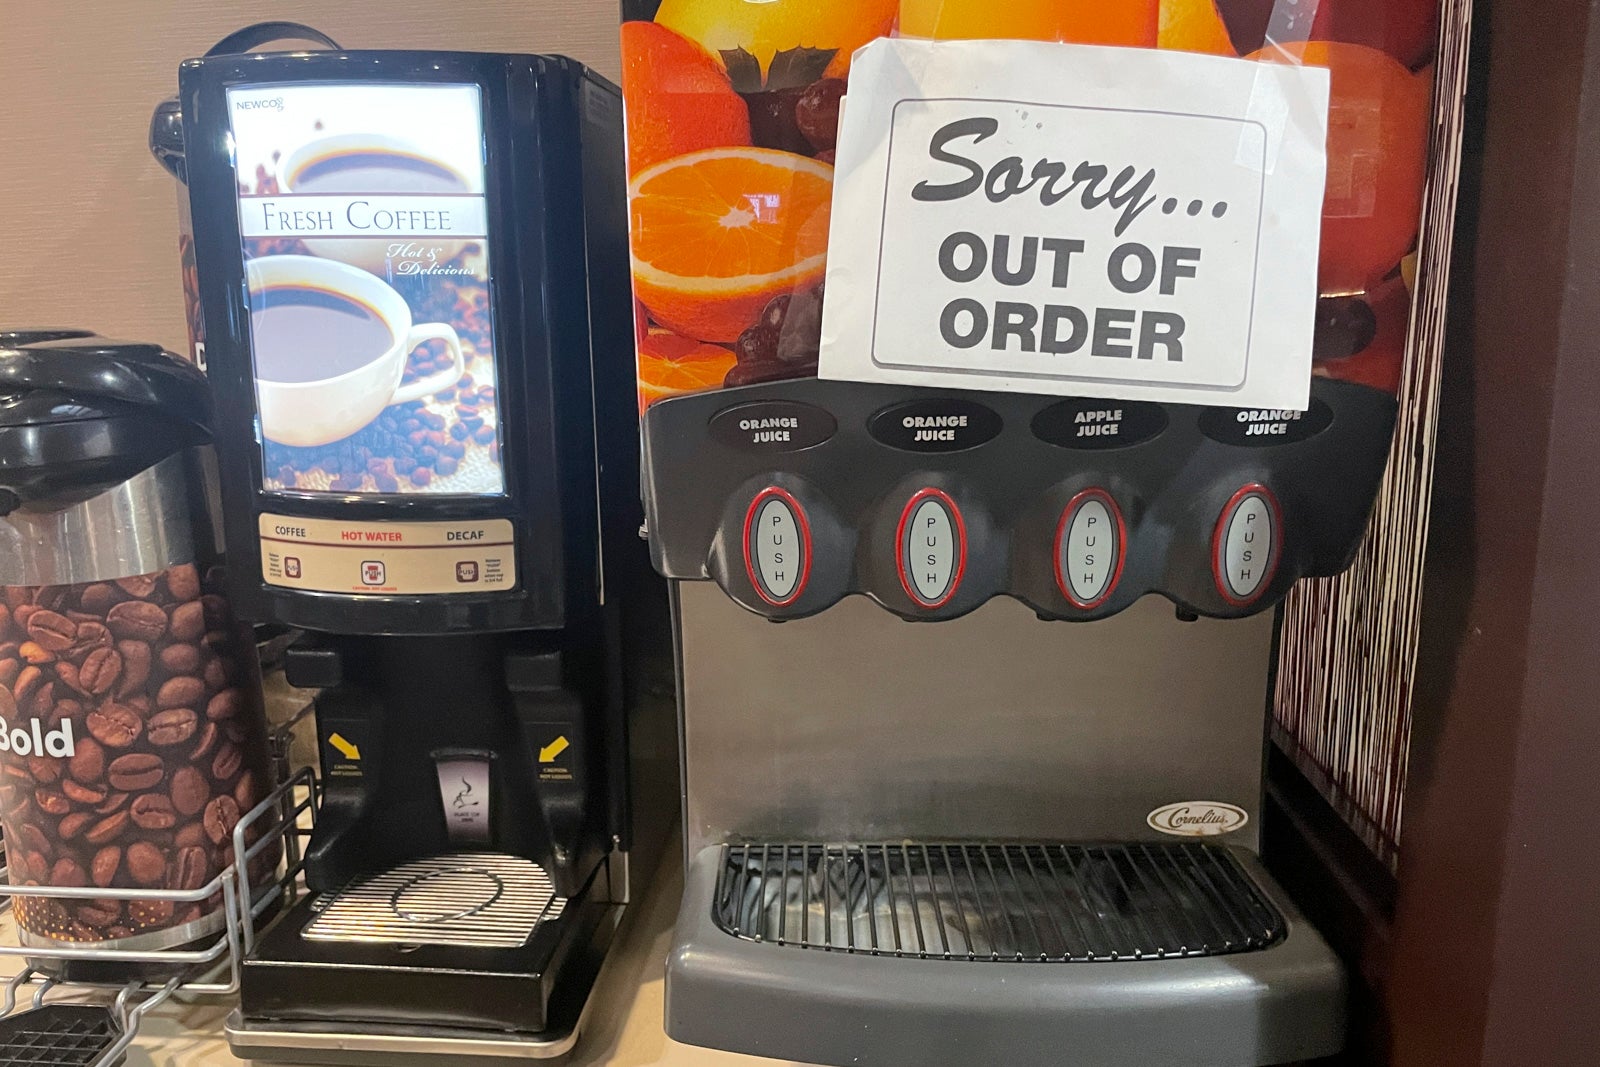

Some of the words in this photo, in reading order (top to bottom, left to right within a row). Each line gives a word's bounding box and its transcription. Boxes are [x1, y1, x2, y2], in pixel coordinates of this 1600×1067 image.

[236, 100, 277, 110] NEWCO
[911, 117, 1228, 237] Sorry...
[346, 201, 452, 231] COFFEE
[386, 242, 423, 258] Hot
[426, 247, 442, 261] &
[396, 260, 475, 276] Delicious
[938, 231, 1085, 289] OUT
[1107, 242, 1202, 296] OF
[939, 298, 1186, 362] ORDER
[902, 415, 968, 428] ORANGE
[1074, 409, 1122, 423] APPLE
[1236, 410, 1301, 422] ORANGE
[739, 417, 798, 430] ORANGE
[1245, 423, 1287, 436] JUICE
[753, 431, 790, 443] JUICE
[914, 429, 955, 441] JUICE
[1076, 424, 1118, 437] JUICE
[275, 526, 306, 538] COFFEE
[341, 531, 363, 542] HOT
[365, 531, 403, 542] WATER
[446, 530, 485, 541] DECAF
[772, 516, 785, 582] PUSH
[926, 518, 937, 584] PUSH
[1083, 517, 1097, 584] PUSH
[1240, 513, 1256, 581] PUSH
